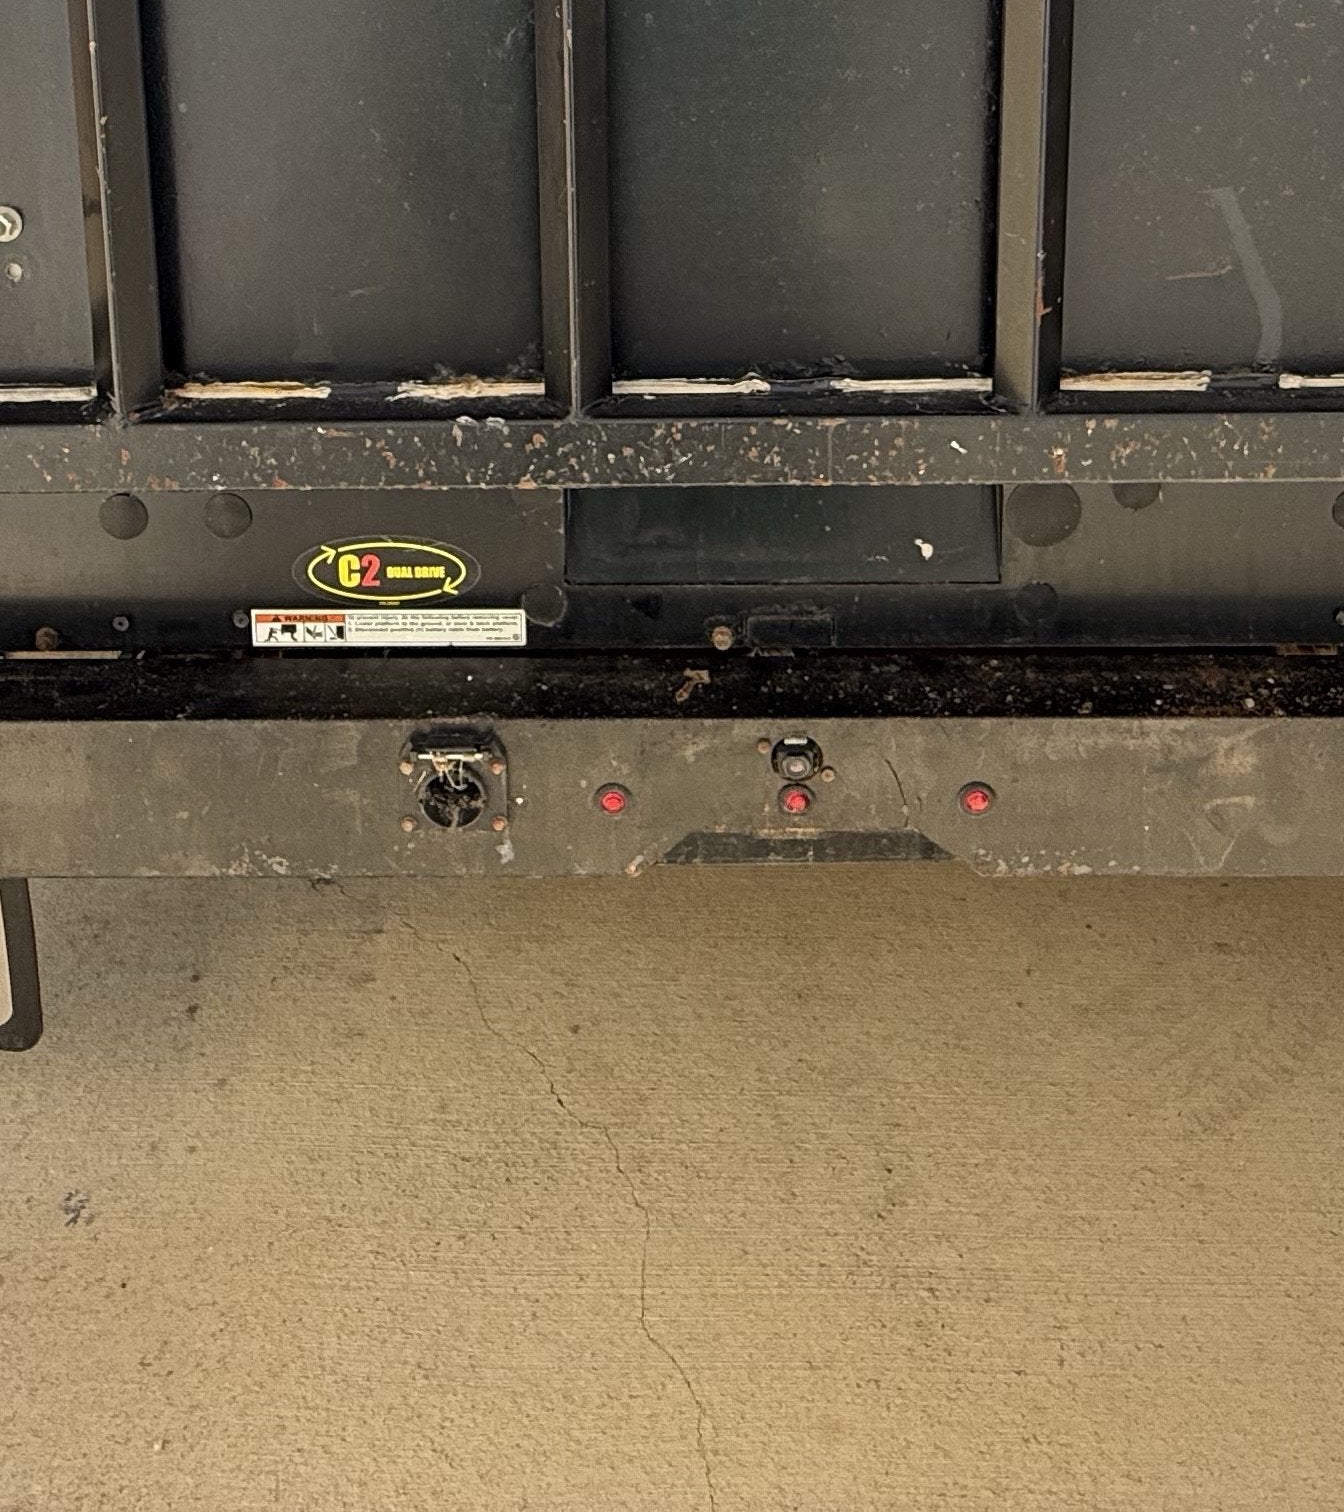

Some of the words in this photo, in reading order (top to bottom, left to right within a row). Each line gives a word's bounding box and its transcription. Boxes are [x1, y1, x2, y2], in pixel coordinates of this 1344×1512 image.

[338, 554, 380, 588] C2
[386, 566, 413, 578] DUAL
[414, 566, 445, 578] DRIVE
